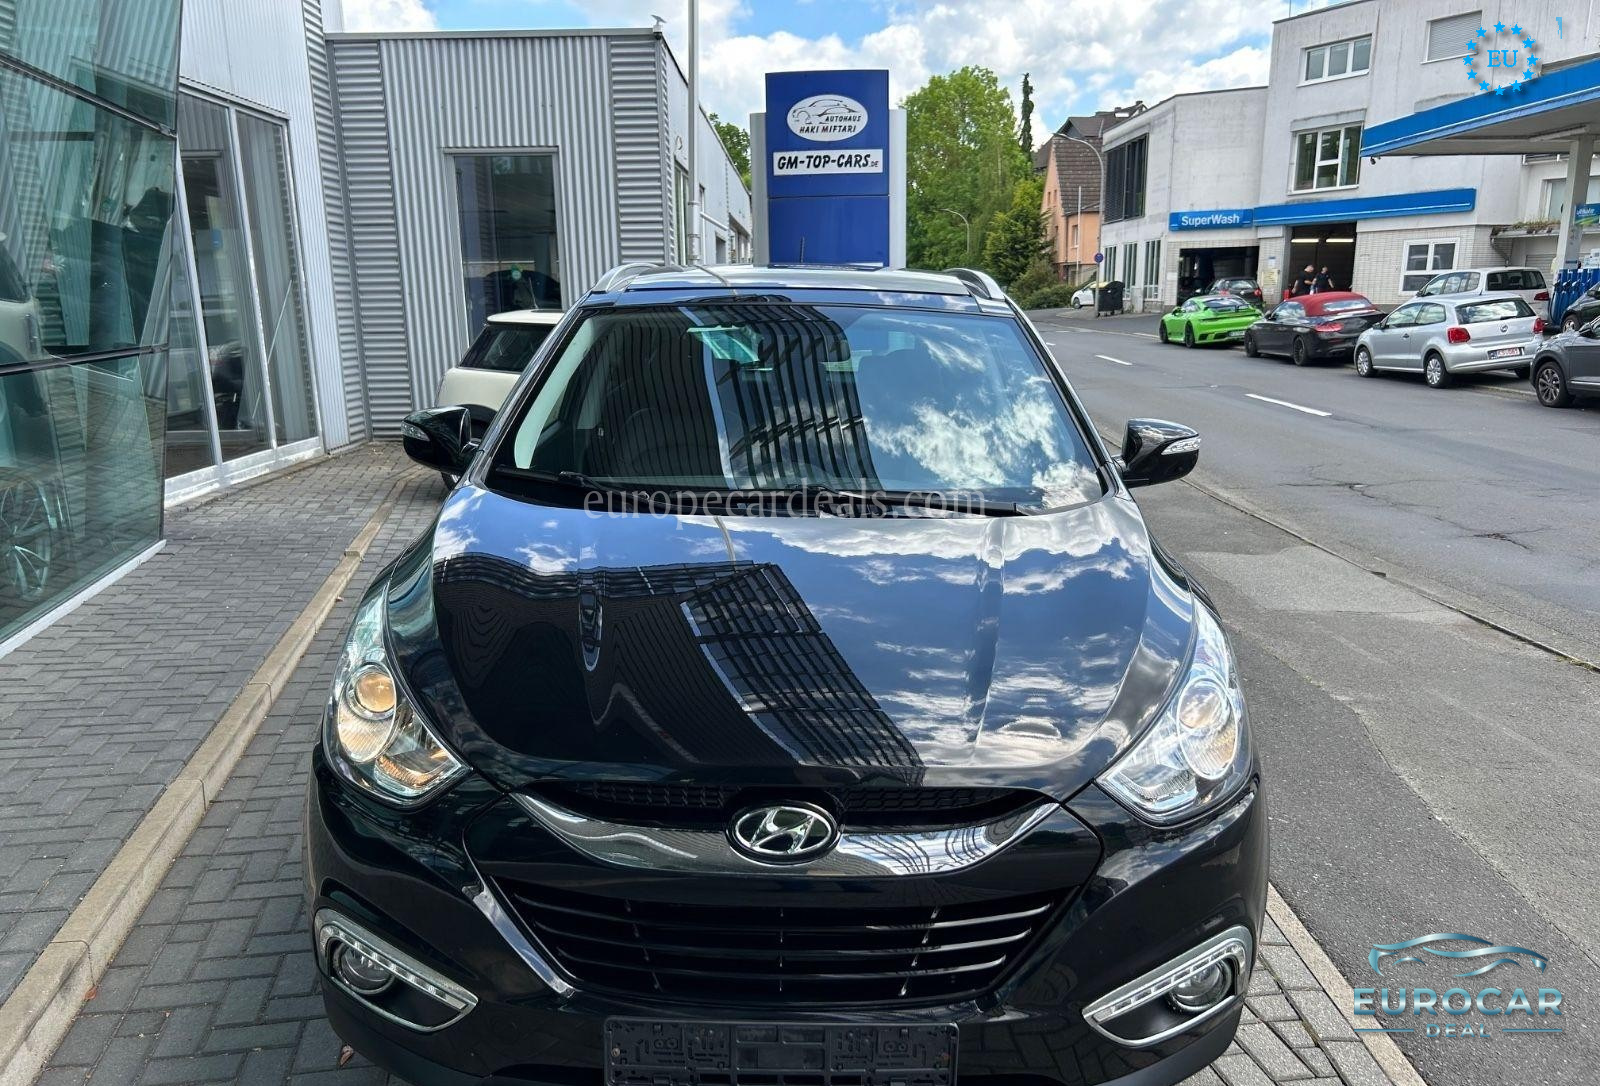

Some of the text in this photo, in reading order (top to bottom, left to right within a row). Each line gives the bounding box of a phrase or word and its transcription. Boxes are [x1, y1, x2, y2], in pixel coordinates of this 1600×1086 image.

[825, 115, 861, 123] AUTOHAUS
[799, 125, 856, 133] HAKI MIFTARI
[1181, 213, 1240, 228] SuperWash
